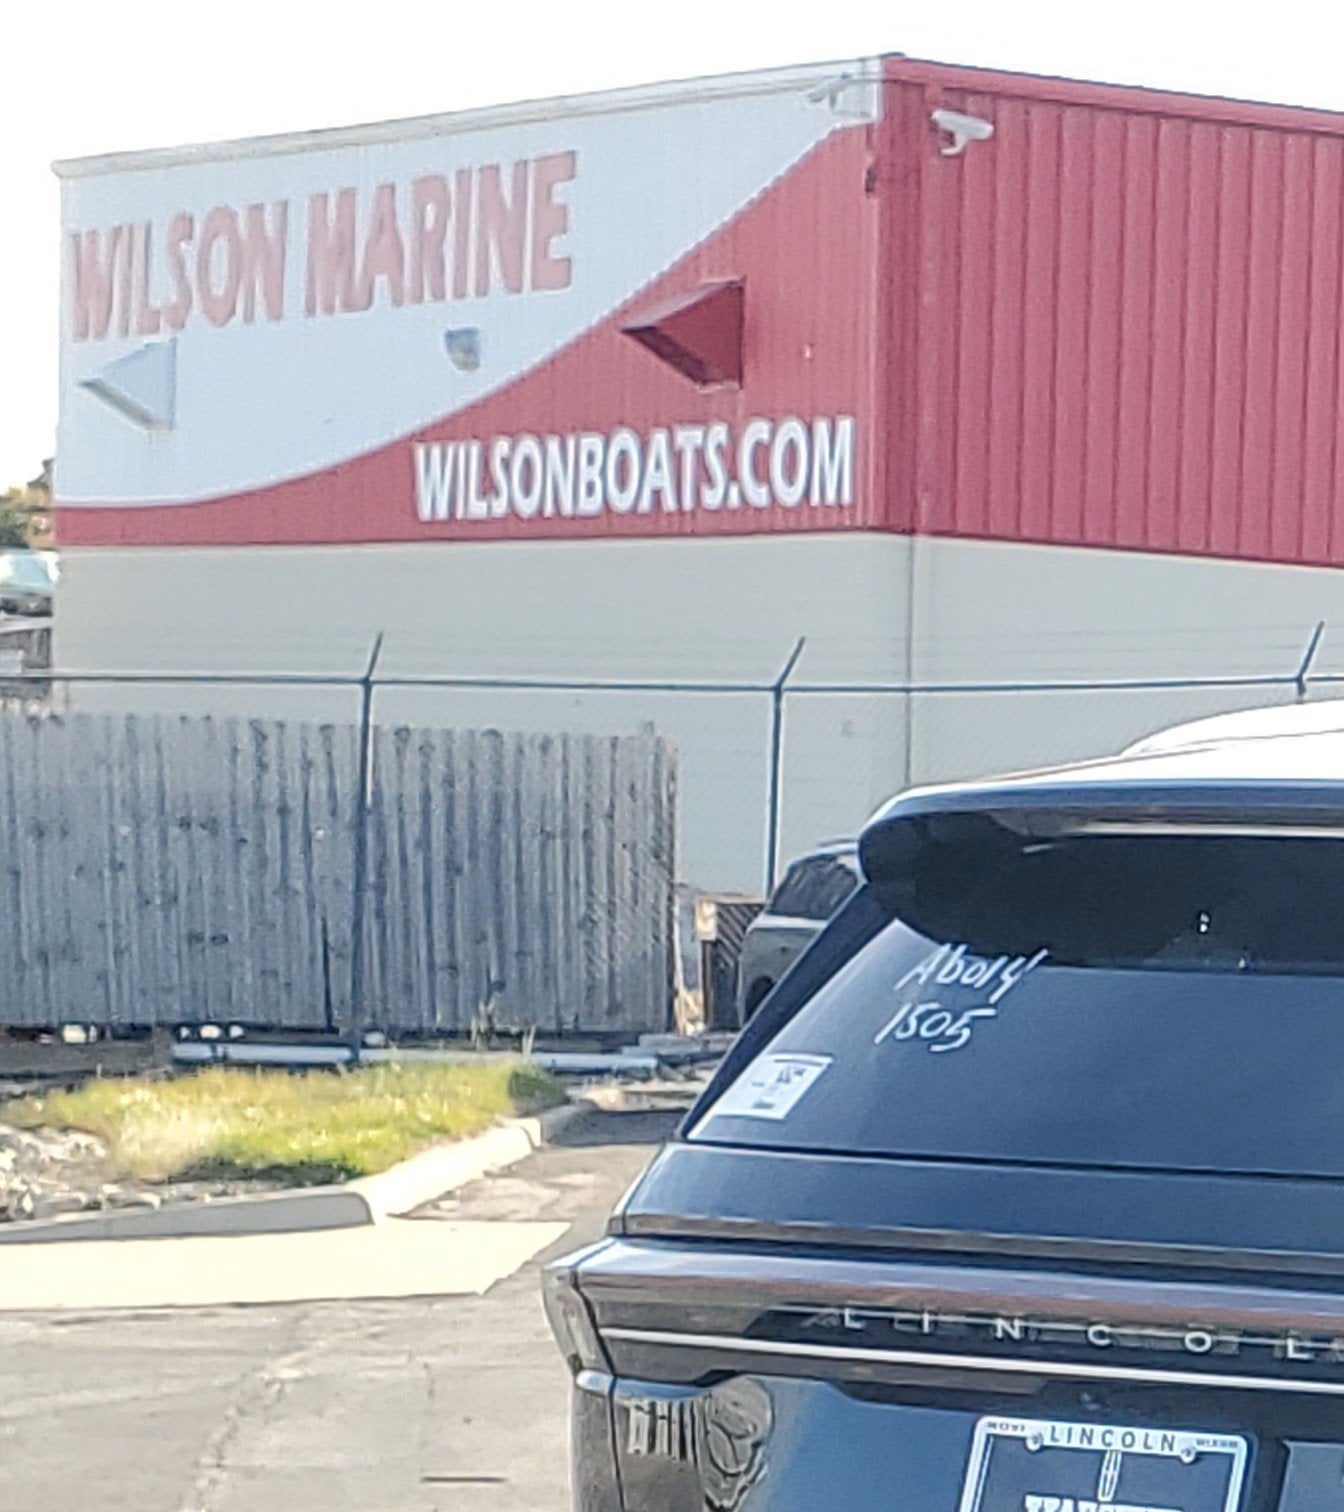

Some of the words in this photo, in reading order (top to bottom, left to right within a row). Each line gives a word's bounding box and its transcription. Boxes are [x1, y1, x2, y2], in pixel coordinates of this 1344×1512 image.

[71, 198, 287, 342] WILSON
[305, 150, 577, 319] MARINE
[414, 415, 857, 522] WILSONBOATS.COM
[874, 1002, 997, 1052] 1505
[1049, 1424, 1176, 1452] LINCOLN
